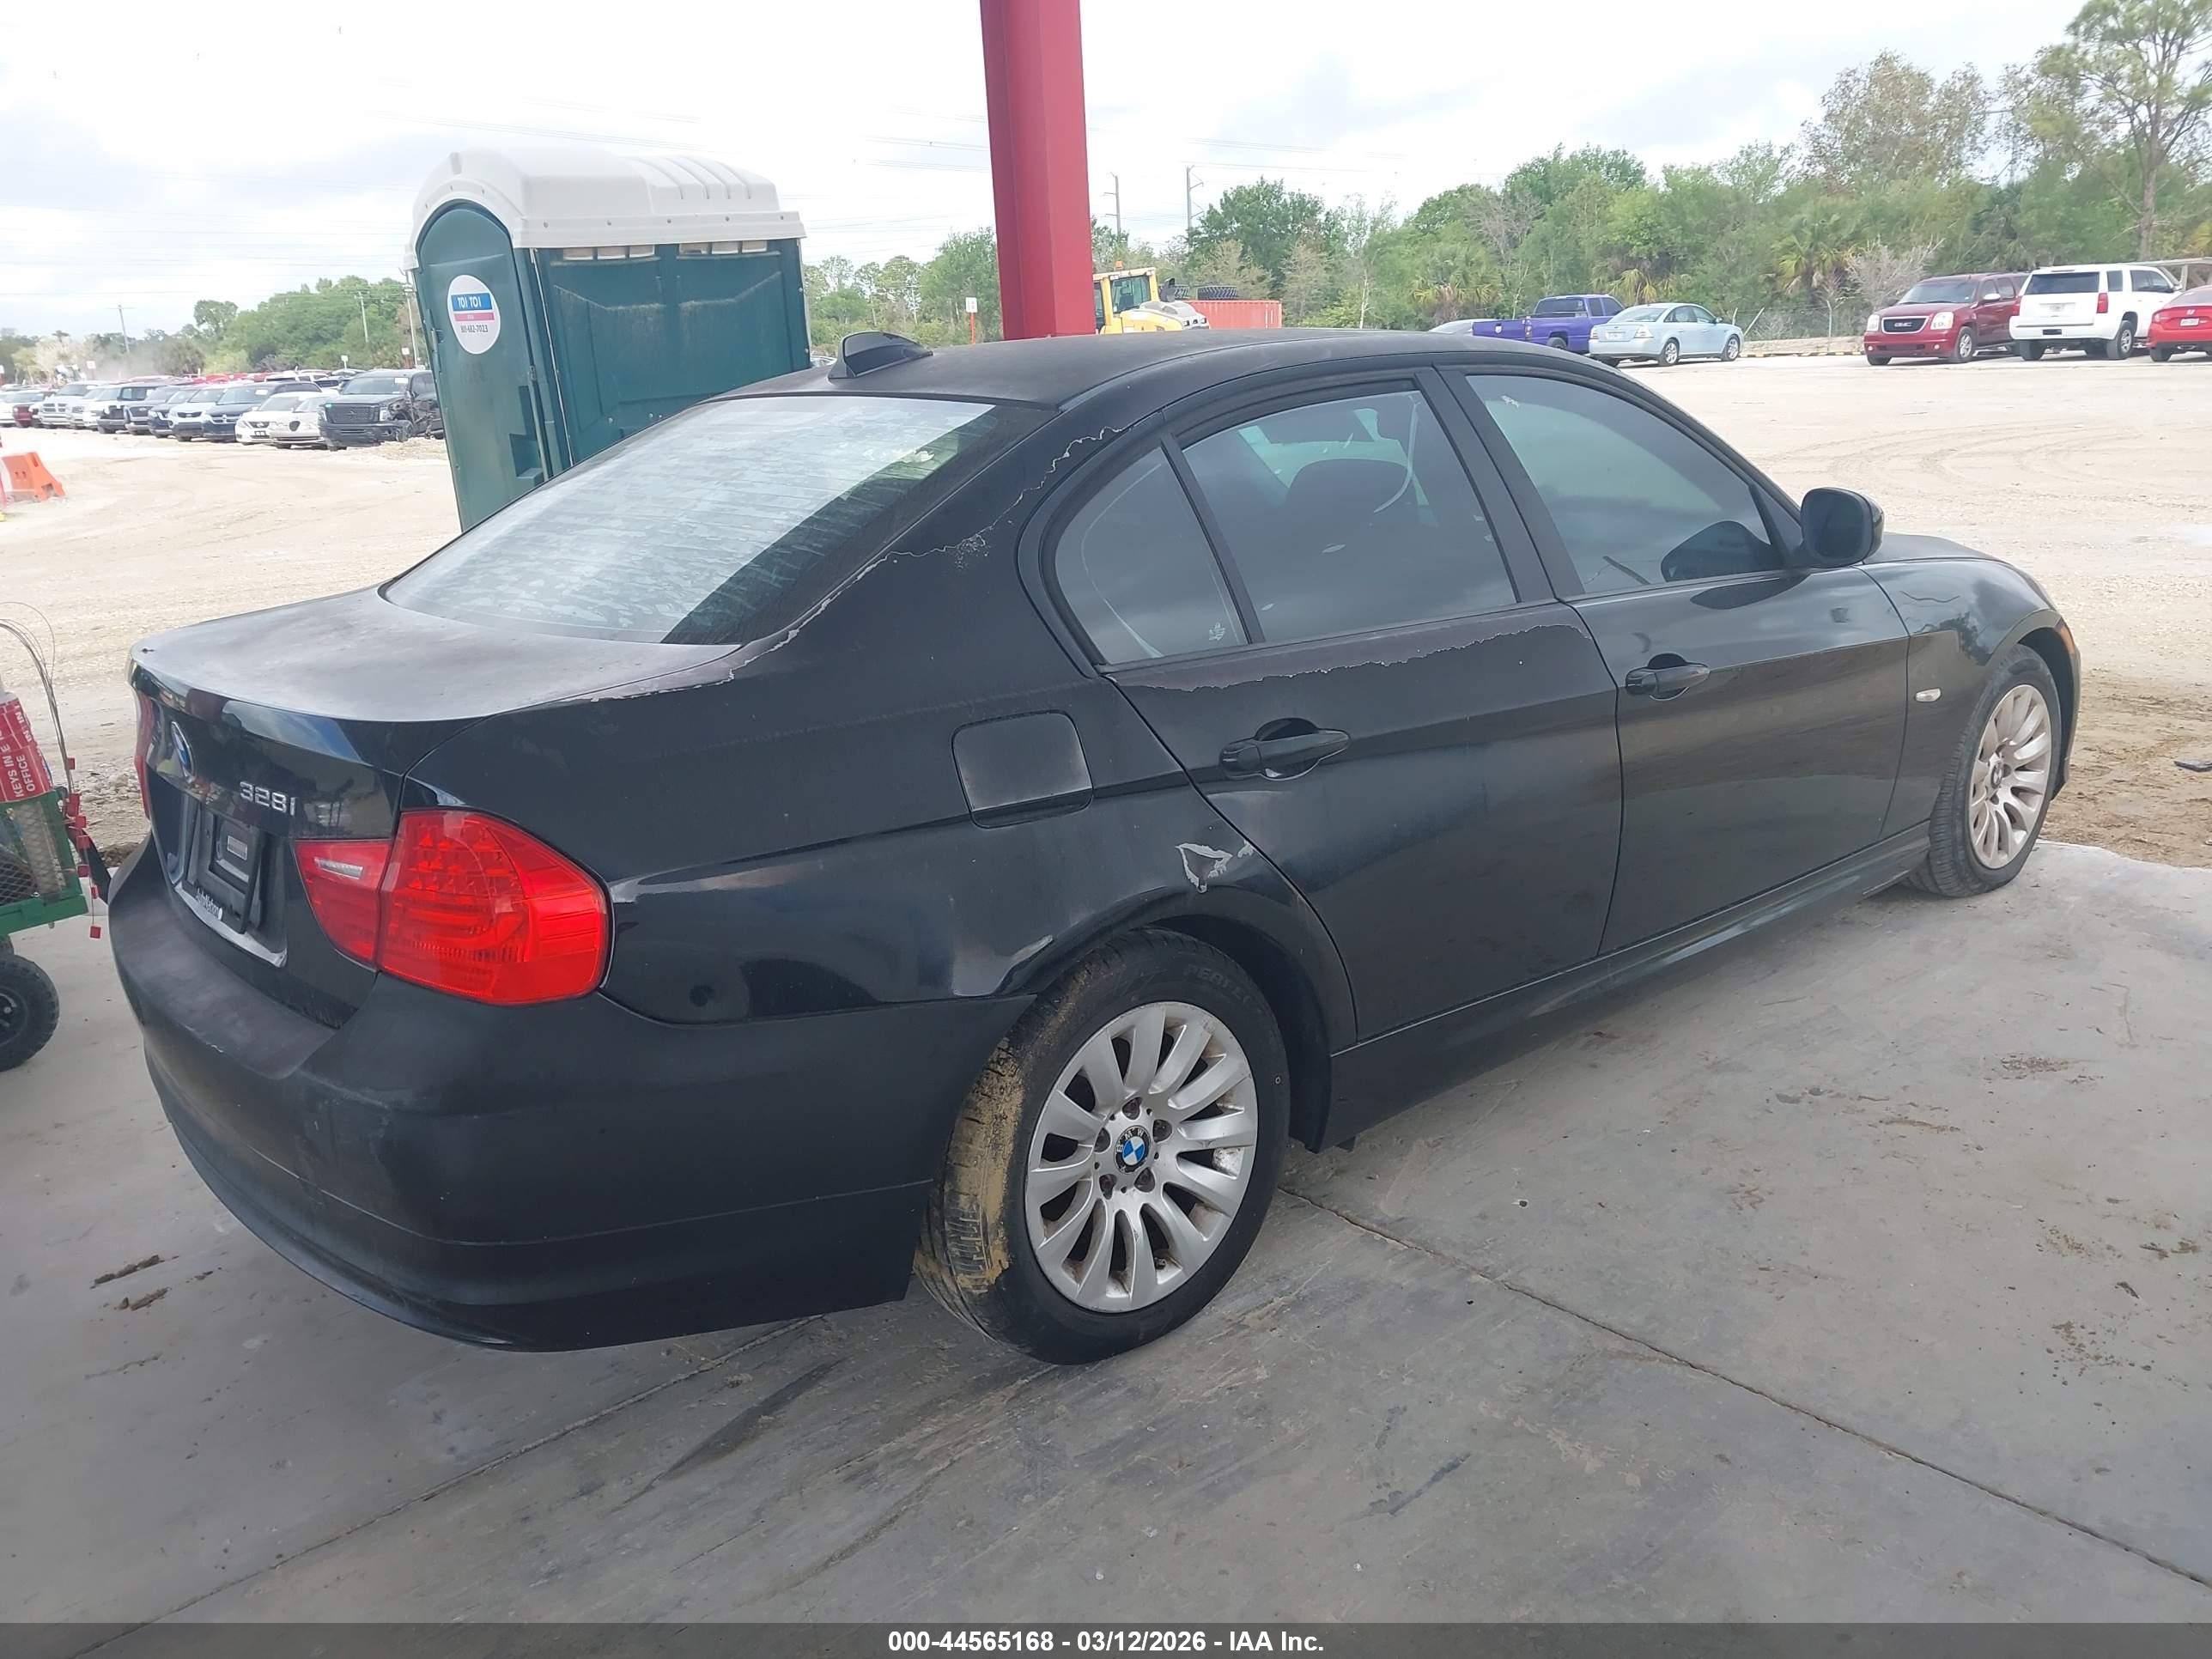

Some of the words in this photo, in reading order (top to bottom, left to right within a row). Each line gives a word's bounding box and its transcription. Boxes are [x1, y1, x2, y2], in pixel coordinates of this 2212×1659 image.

[469, 295, 482, 308] TOI
[3, 756, 15, 768] IN
[8, 769, 25, 797] KEYS
[16, 755, 35, 792] OFFICE
